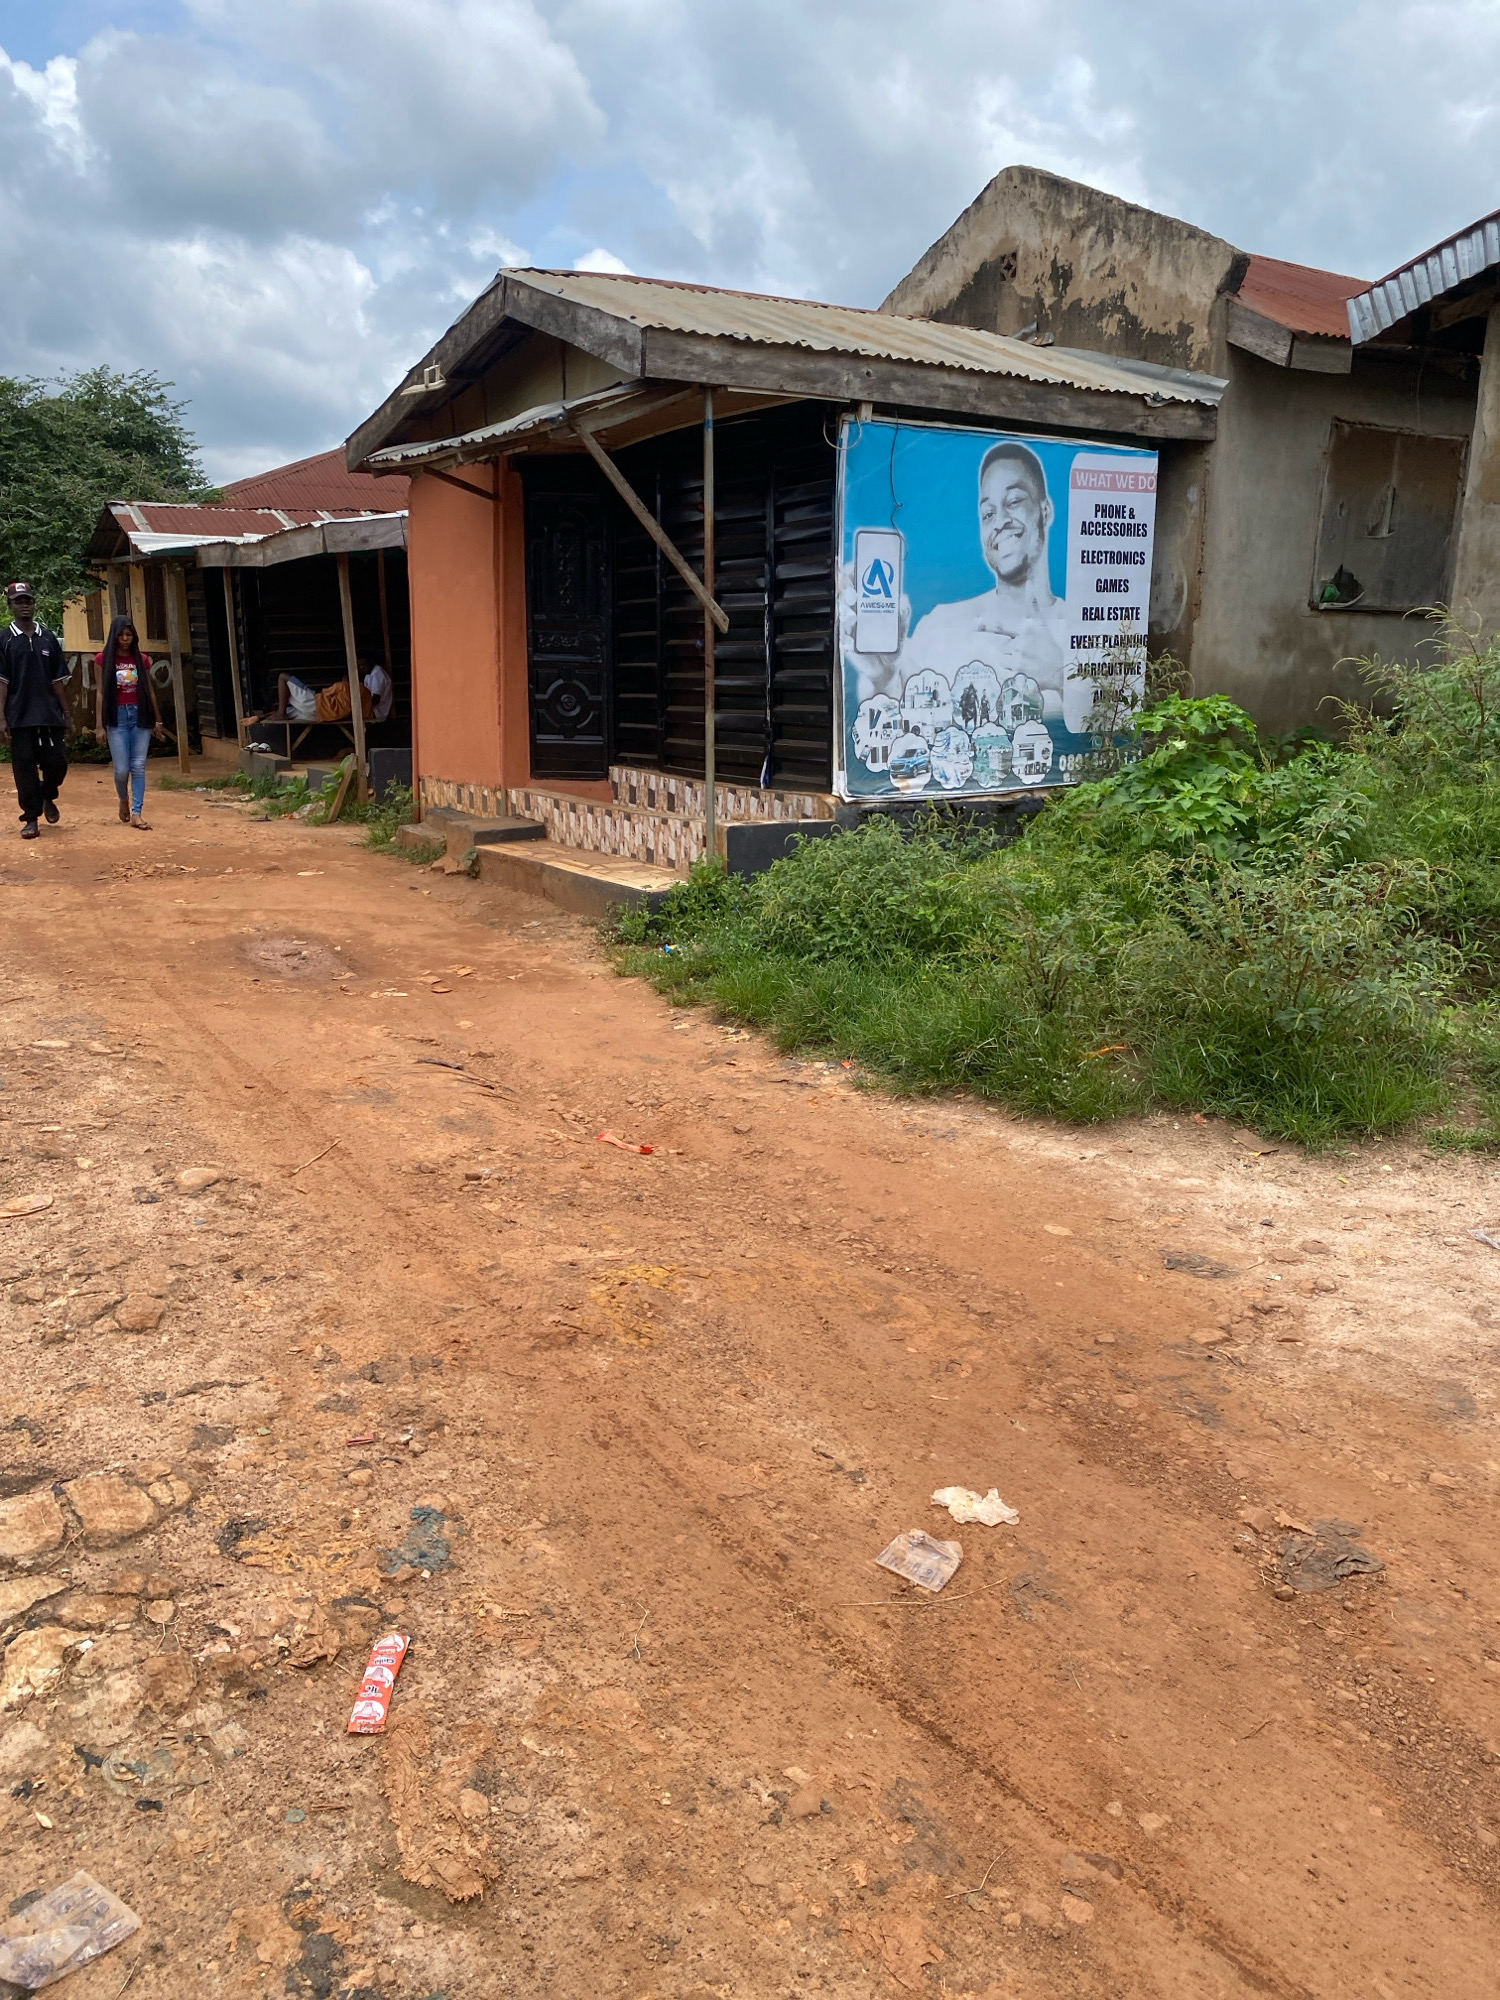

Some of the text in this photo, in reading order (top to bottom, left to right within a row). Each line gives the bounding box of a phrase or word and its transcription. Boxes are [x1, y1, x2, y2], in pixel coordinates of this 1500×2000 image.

[1075, 471, 1157, 490] WHAT WE DO
[1094, 503, 1136, 520] PHONE &
[1080, 521, 1148, 537] ACCESSORIES
[1080, 550, 1146, 565] ELECTRONICS
[1095, 578, 1129, 593] GAMES
[1082, 606, 1141, 621] REAL ESTATE
[1070, 634, 1101, 649] EVENT
